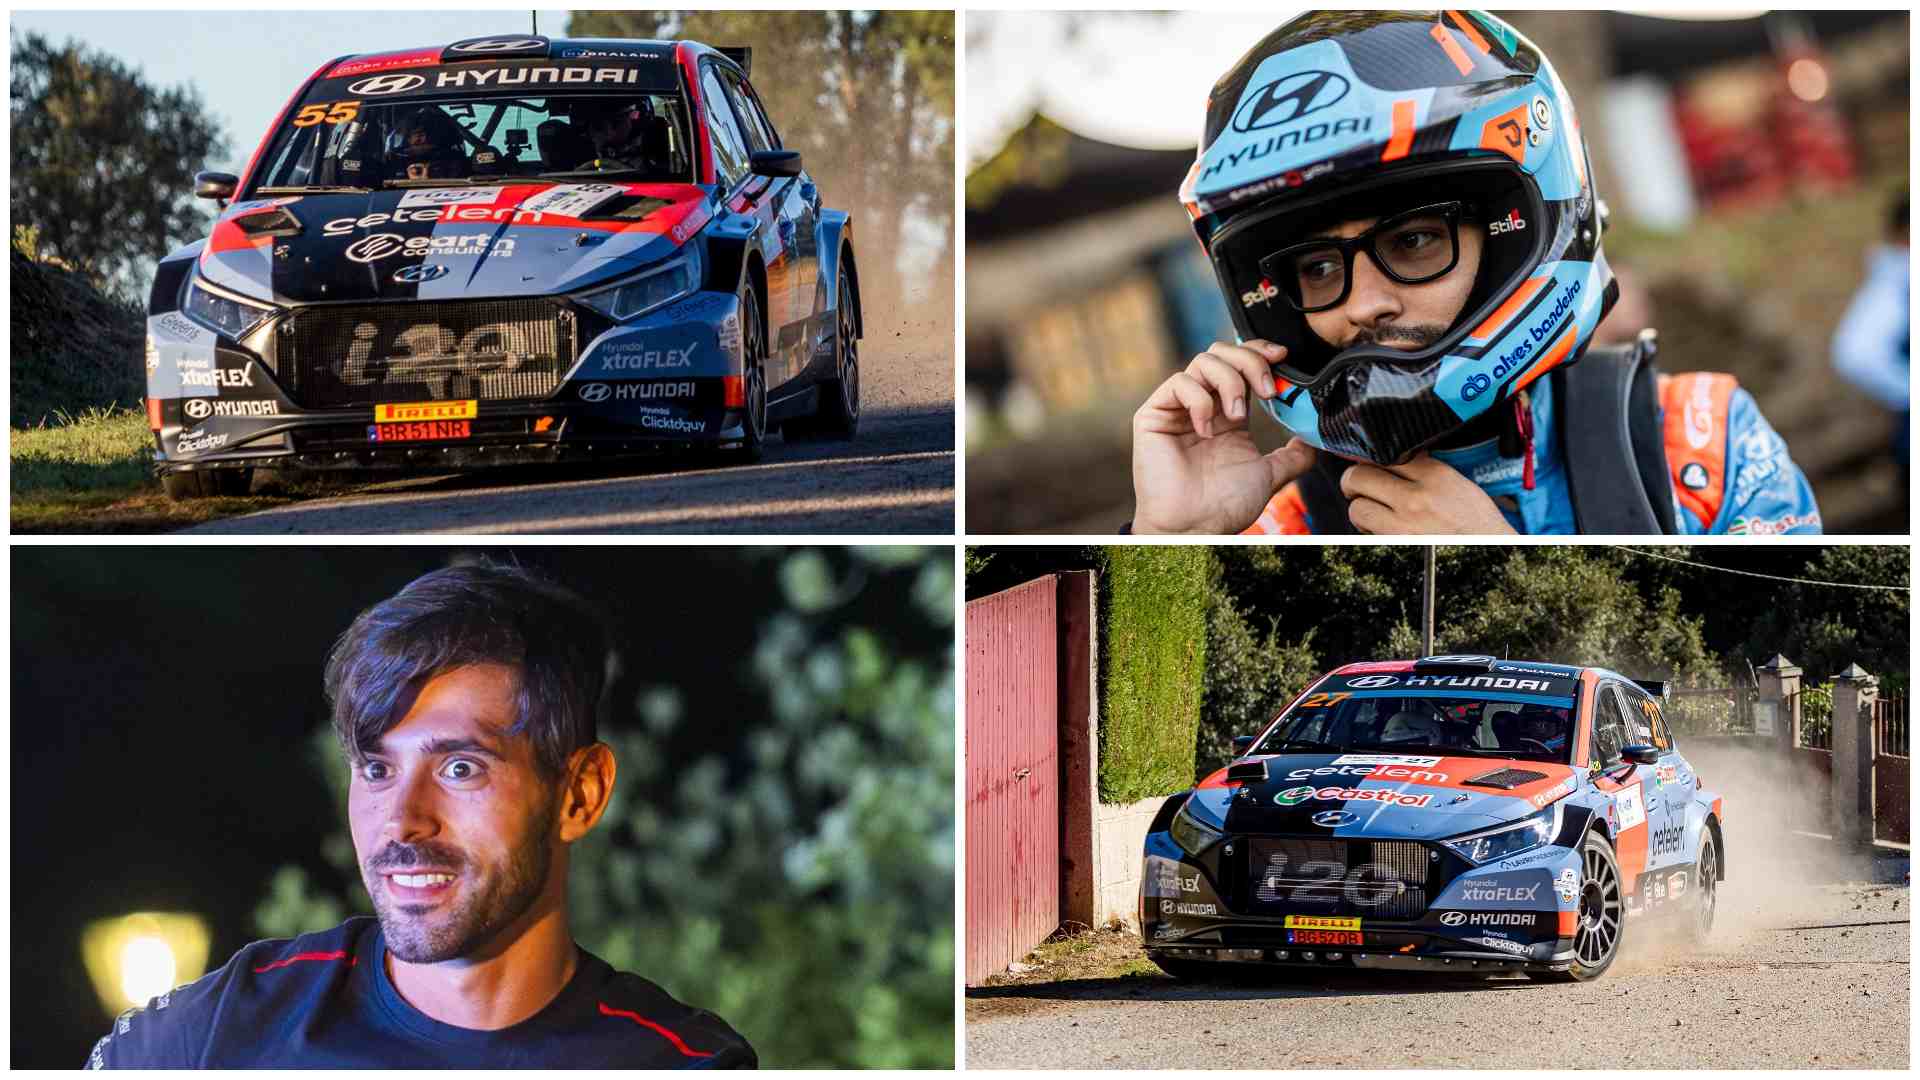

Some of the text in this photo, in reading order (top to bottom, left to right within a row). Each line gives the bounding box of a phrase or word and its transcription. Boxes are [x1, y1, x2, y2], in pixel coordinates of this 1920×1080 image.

[436, 67, 640, 87] HYUNDAI
[293, 101, 361, 127] 55
[1201, 116, 1374, 182] HYUNDAI
[323, 205, 544, 237] cetelem
[1489, 211, 1527, 236] Stilo
[1492, 339, 1533, 379] alves
[1529, 279, 1582, 342] bandeira
[602, 342, 698, 370] xtraFLEX
[616, 382, 696, 399] HYUNDAI
[212, 400, 280, 416] HYUNDAI
[1404, 675, 1551, 691] HYUNDAI
[1284, 765, 1449, 783] cetelem
[1314, 786, 1434, 808] Castrol
[1461, 882, 1541, 901] xtraFLEX
[1469, 912, 1537, 926] HYUNDAI
